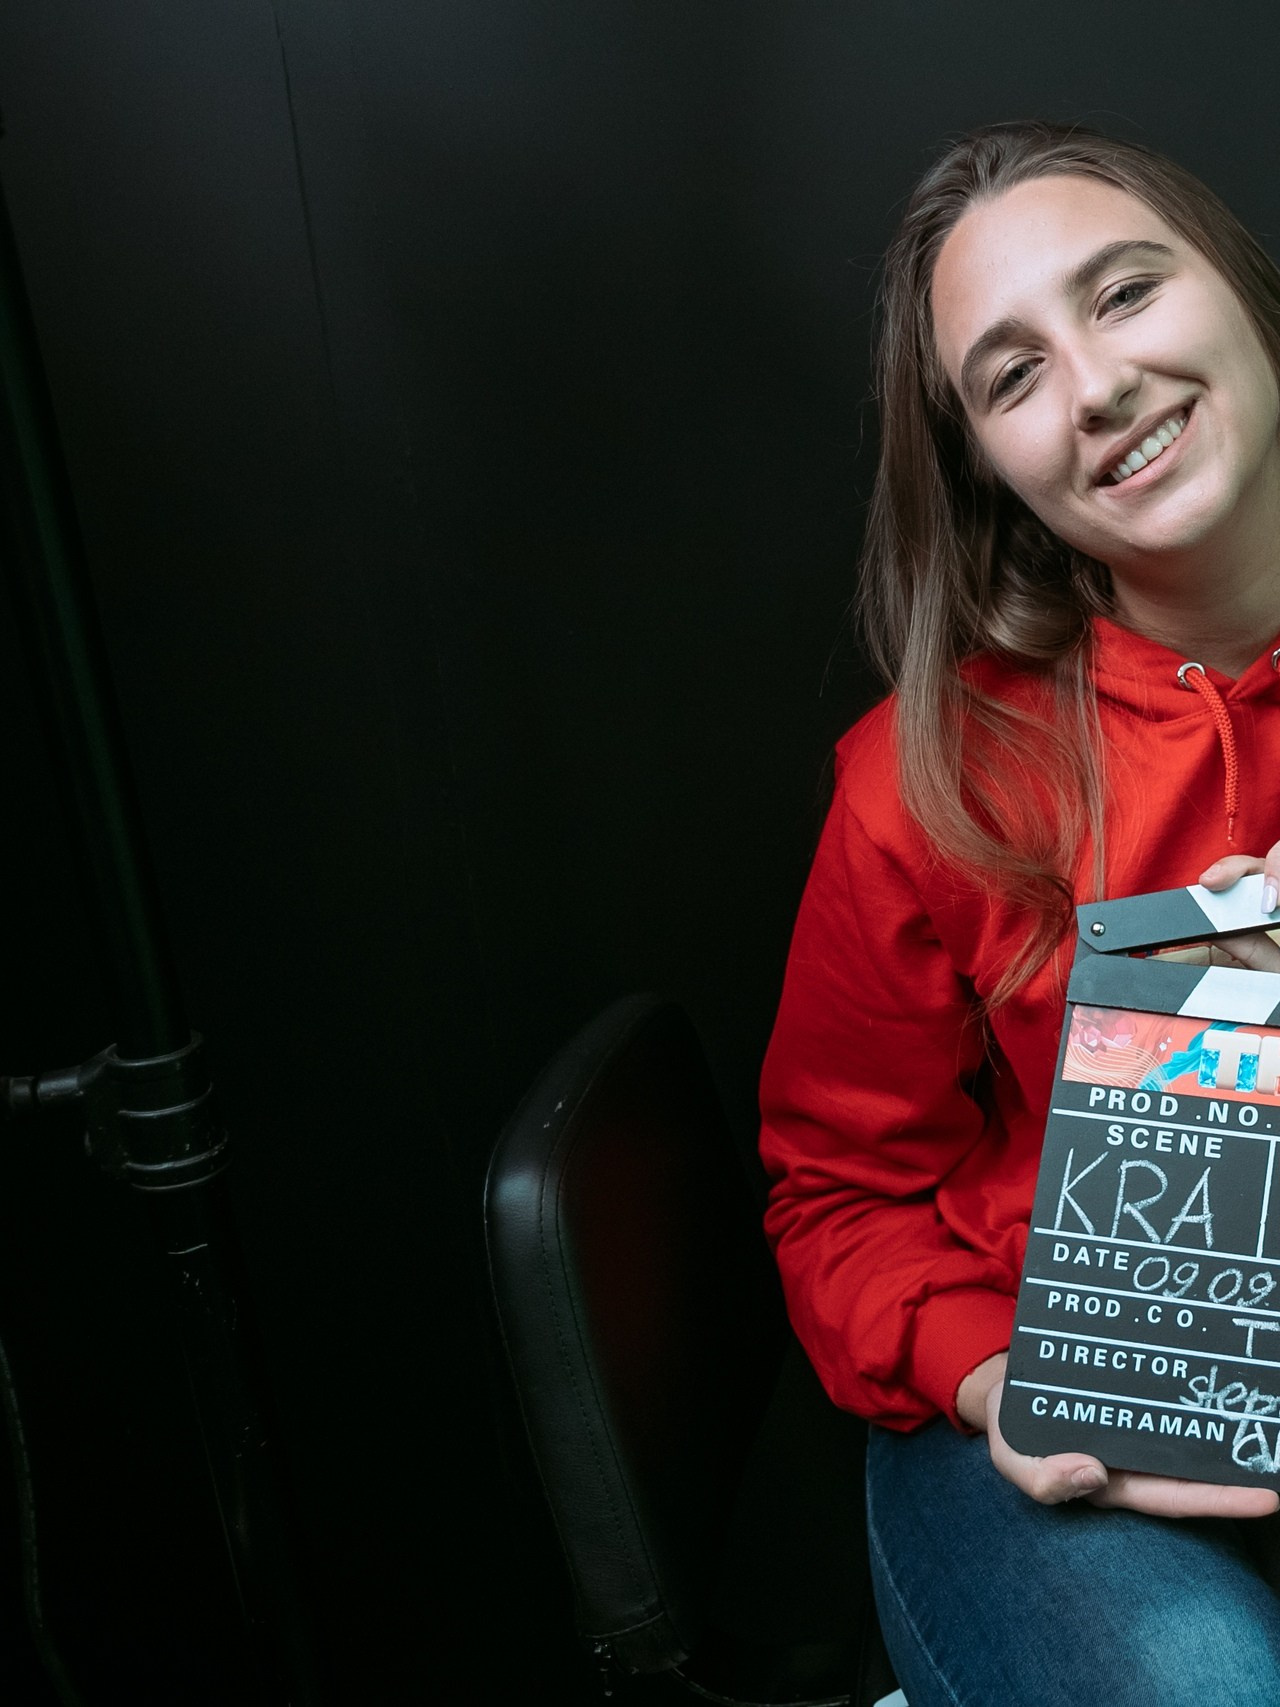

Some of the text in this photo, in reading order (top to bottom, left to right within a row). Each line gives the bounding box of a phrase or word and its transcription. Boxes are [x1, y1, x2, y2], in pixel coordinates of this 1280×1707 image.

[1088, 1086, 1179, 1117] PROD
[1106, 1124, 1223, 1159] SCENE
[1055, 1147, 1215, 1249] KRA
[1052, 1242, 1130, 1271] DATE
[1047, 1290, 1122, 1319] PROD
[1038, 1339, 1190, 1380] DIRECTOR
[1030, 1396, 1226, 1442] CAMERAMAN
